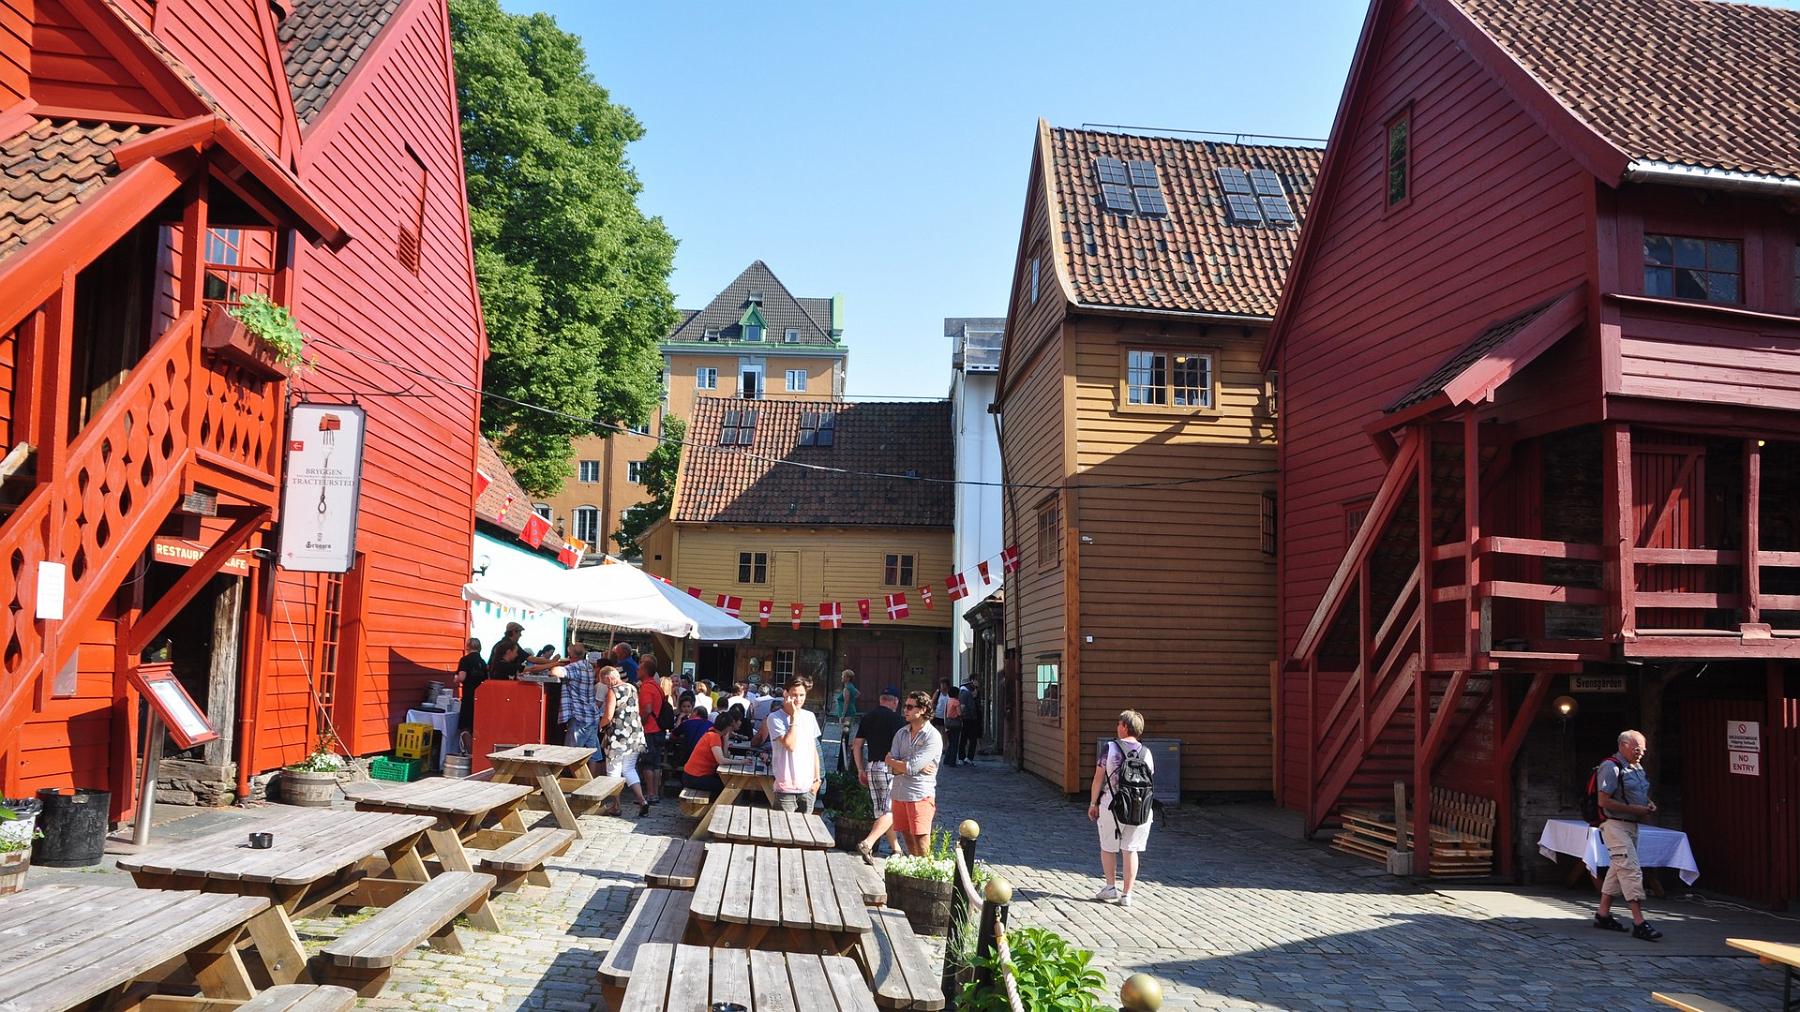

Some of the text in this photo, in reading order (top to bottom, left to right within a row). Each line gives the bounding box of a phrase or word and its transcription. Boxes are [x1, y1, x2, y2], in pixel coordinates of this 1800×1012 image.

[156, 544, 204, 560] RESTAURA
[1738, 754, 1749, 762] NO
[1733, 763, 1755, 771] ENTRY
